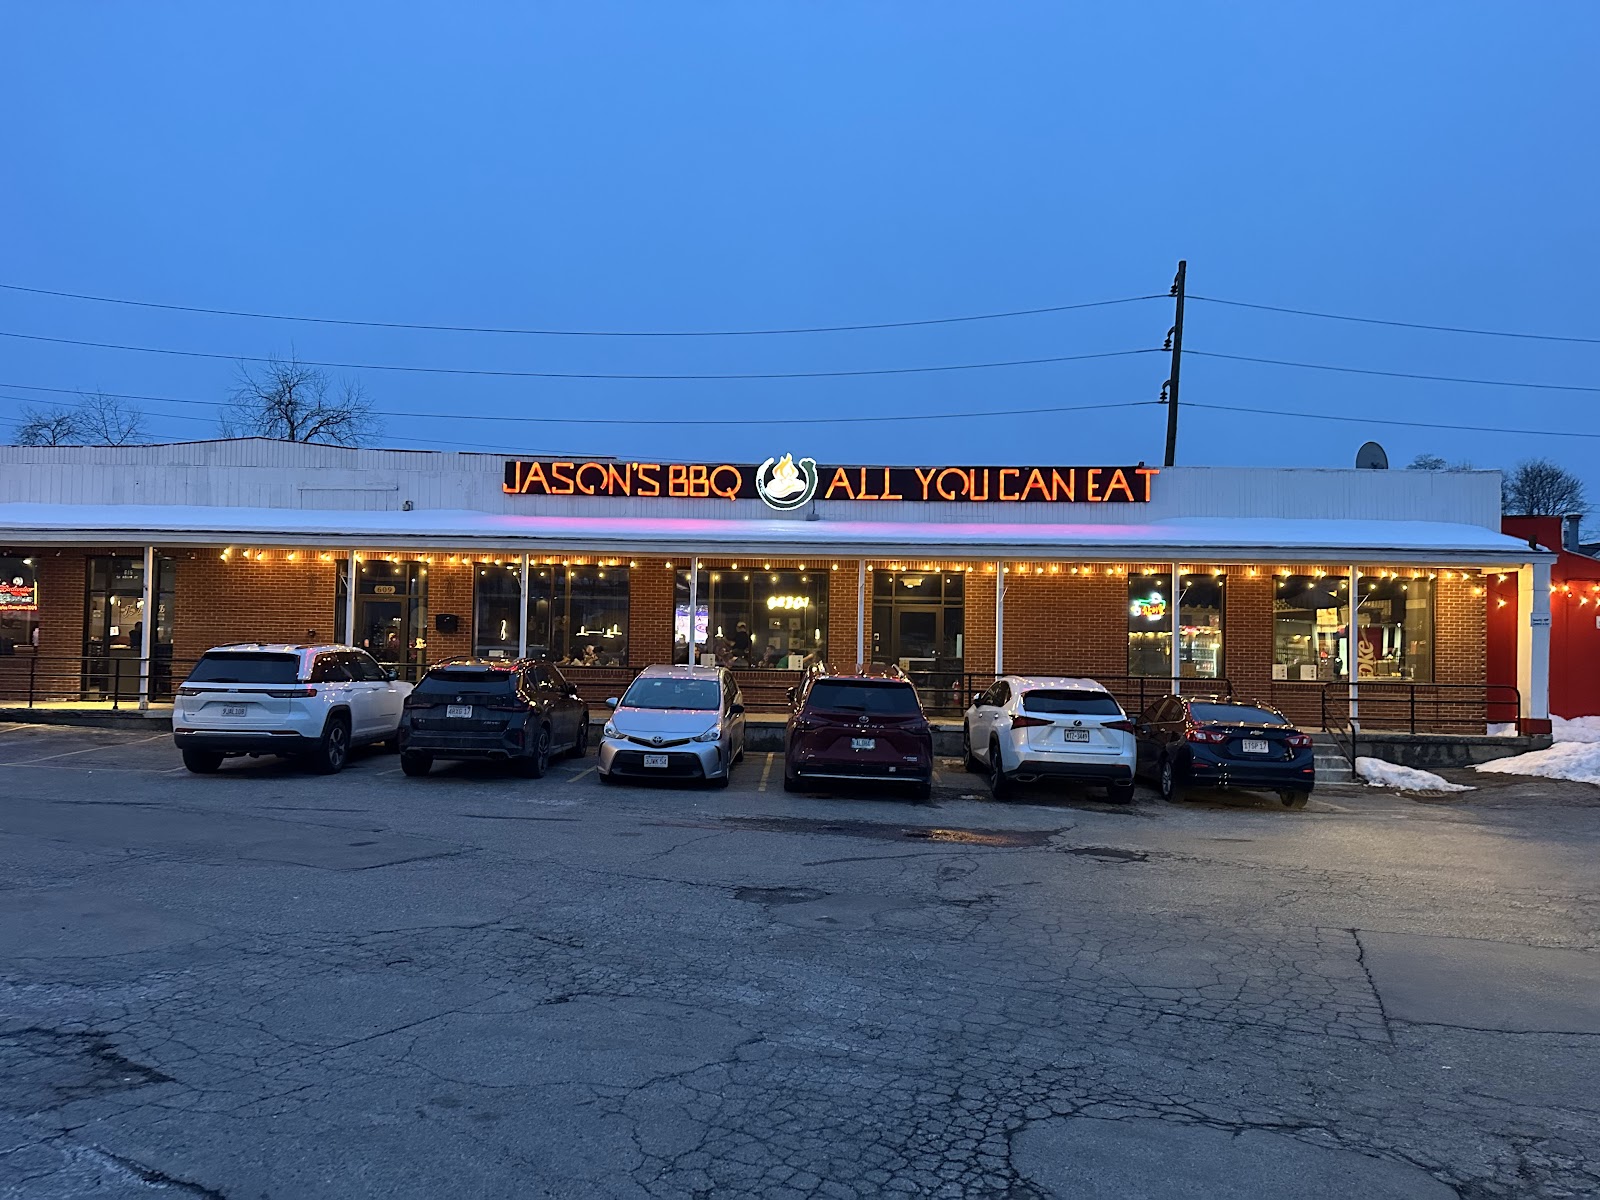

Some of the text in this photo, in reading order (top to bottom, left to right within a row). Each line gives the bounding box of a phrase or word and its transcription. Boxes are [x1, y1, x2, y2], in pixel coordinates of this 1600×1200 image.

[502, 461, 660, 497] JASON'S
[668, 464, 742, 501] BBQ
[825, 467, 1160, 502] ALL YOU CAN EAT
